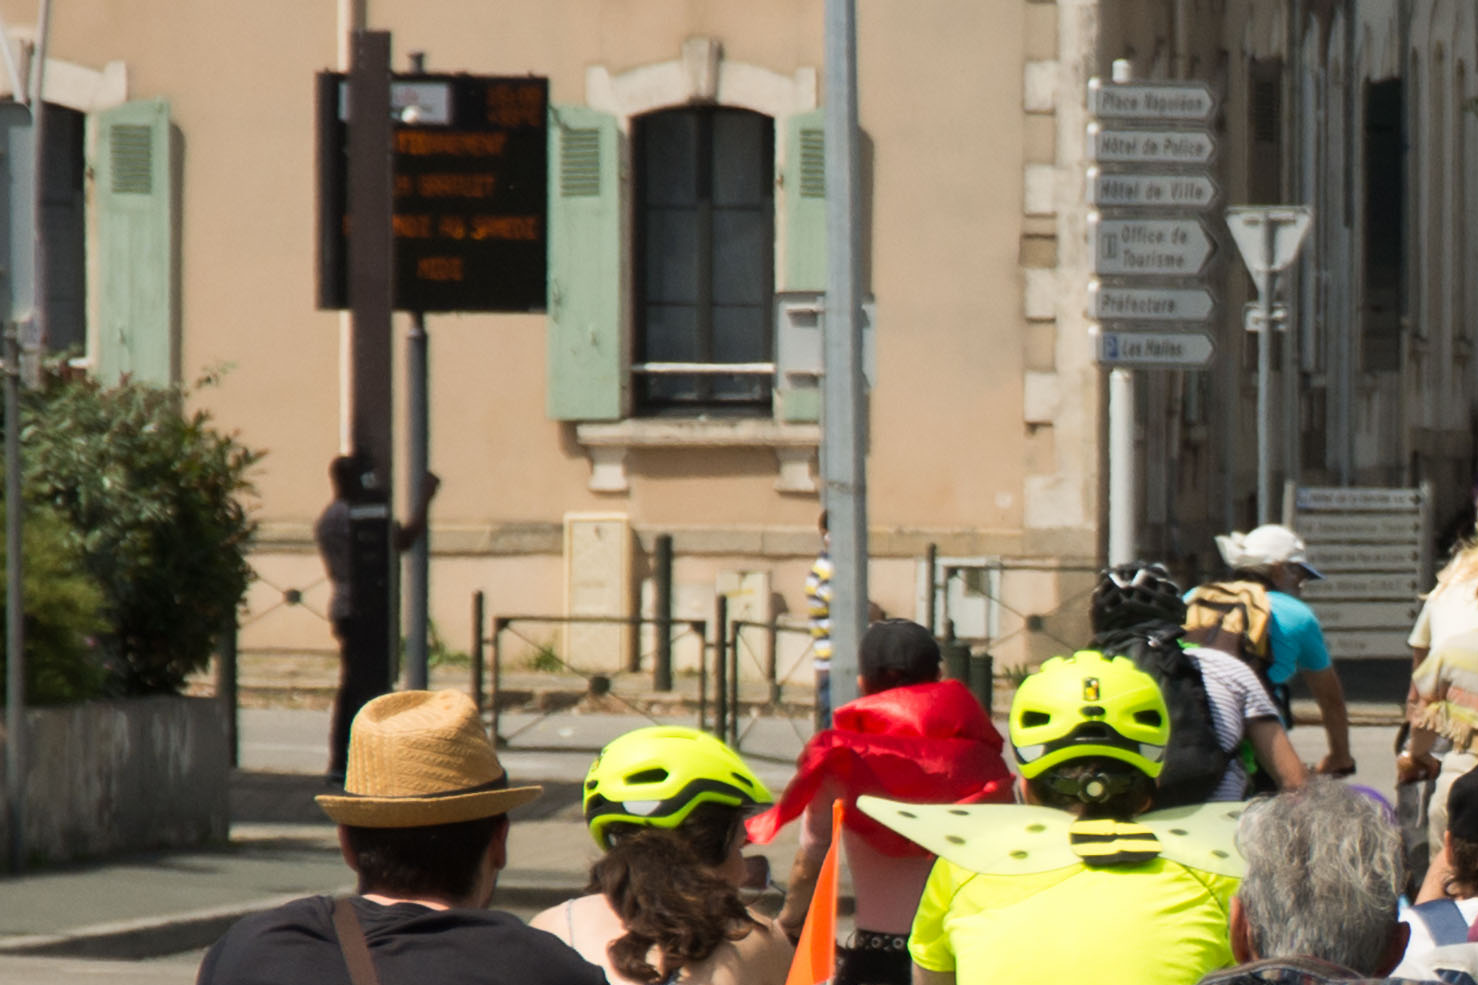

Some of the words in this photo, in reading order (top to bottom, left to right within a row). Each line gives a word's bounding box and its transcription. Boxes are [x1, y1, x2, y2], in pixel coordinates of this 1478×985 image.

[1102, 91, 1137, 109] Place
[1144, 91, 1203, 113] Napoléon
[1101, 135, 1137, 153] Hôtel
[1142, 136, 1159, 154] de
[1163, 138, 1205, 157] Police
[1100, 179, 1138, 198] Hôtel
[1145, 181, 1162, 199] de
[1170, 182, 1203, 200] Ville
[1120, 225, 1165, 244] Office
[1170, 226, 1188, 245] de
[1121, 250, 1186, 268] Tourisme
[1101, 294, 1175, 313] Préfecture
[1122, 338, 1142, 358] Les
[1144, 338, 1183, 358] Halles
